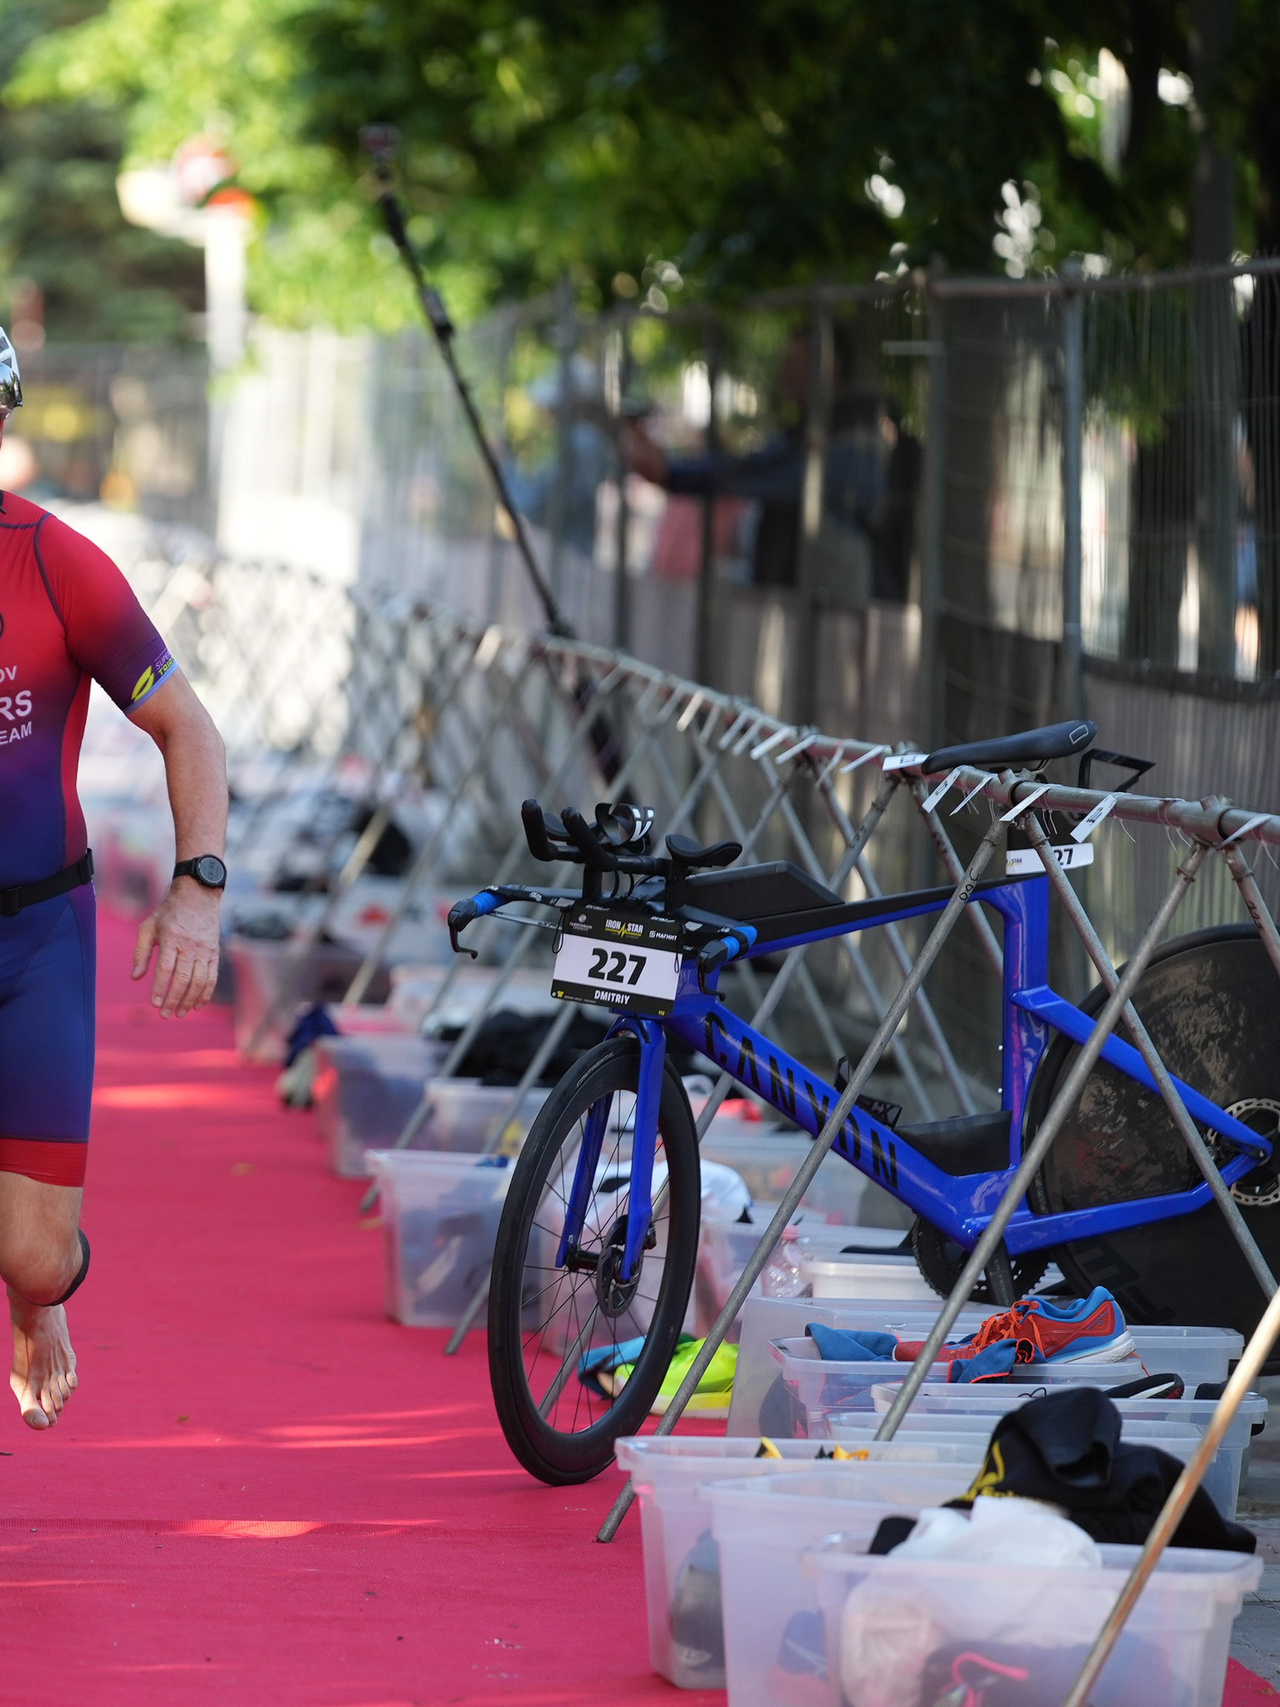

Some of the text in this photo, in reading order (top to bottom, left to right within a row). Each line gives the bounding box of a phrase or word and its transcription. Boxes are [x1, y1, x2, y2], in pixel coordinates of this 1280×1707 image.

[605, 918, 622, 930] IRON
[627, 922, 644, 934] STAR
[587, 947, 648, 987] 227
[594, 989, 631, 1005] DMITRIY
[704, 1011, 899, 1190] CANYON
